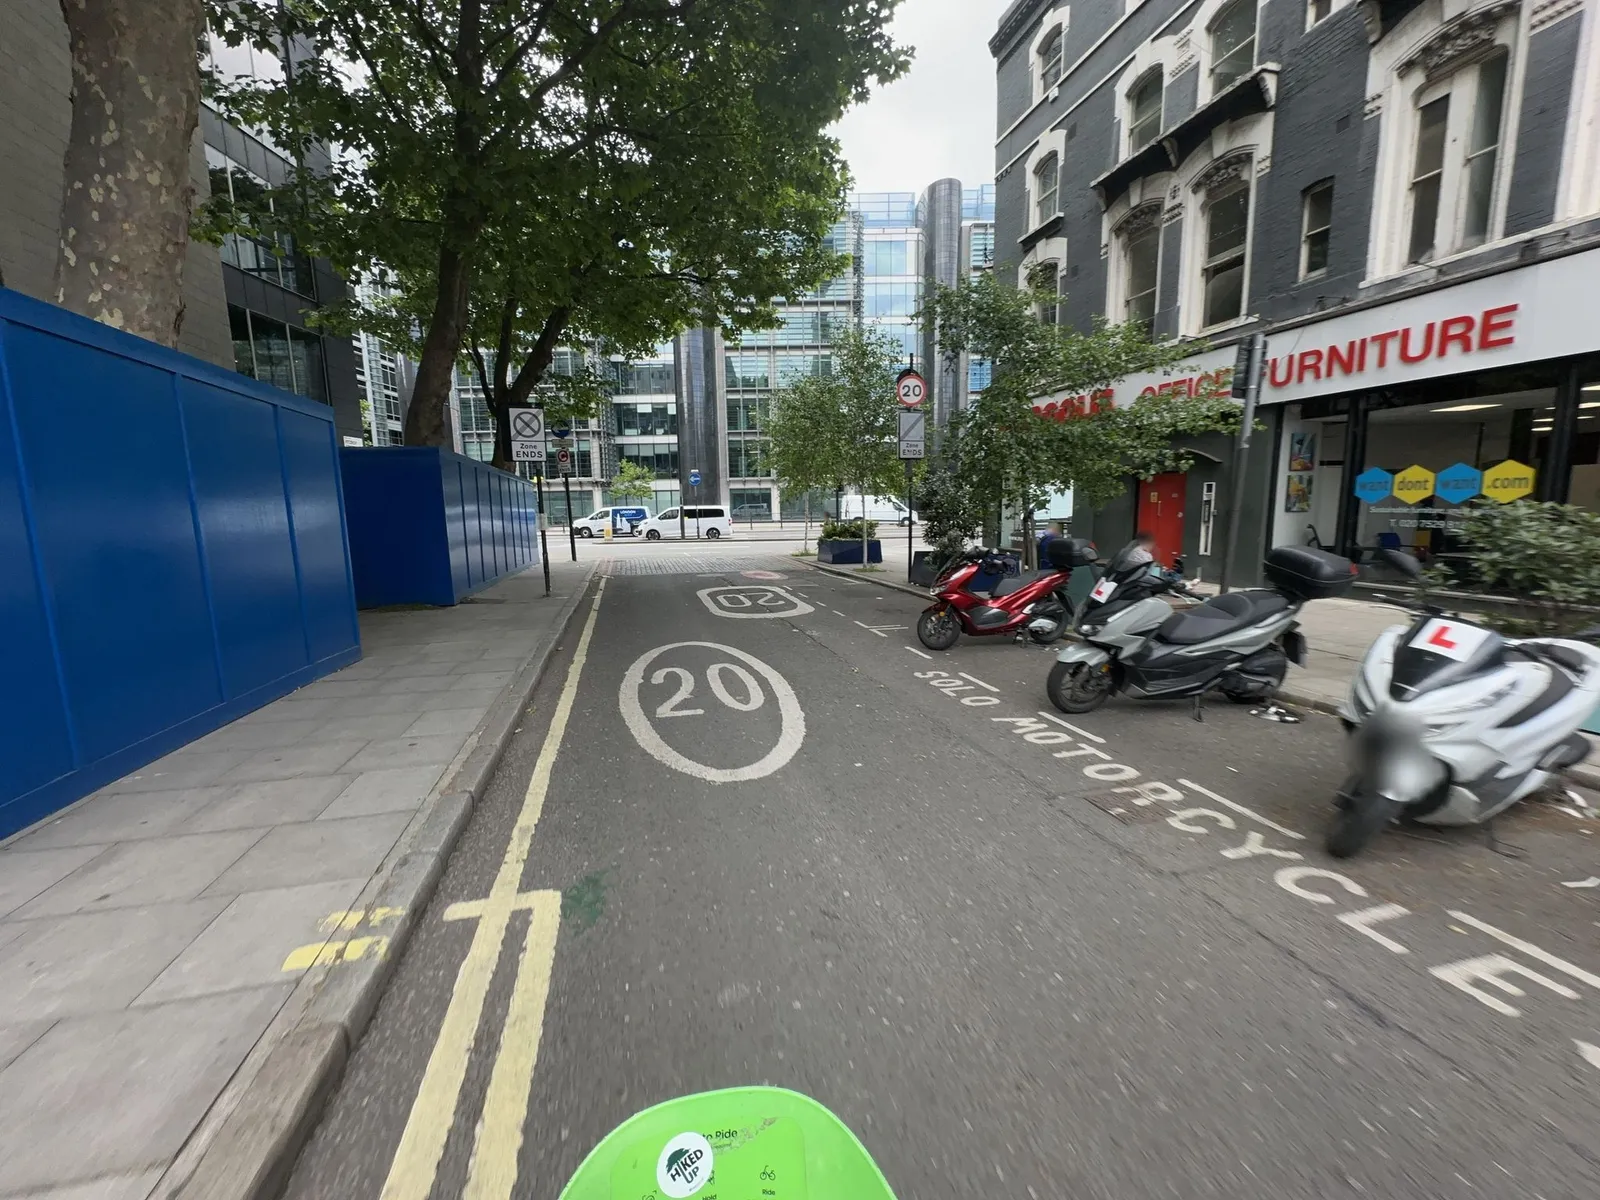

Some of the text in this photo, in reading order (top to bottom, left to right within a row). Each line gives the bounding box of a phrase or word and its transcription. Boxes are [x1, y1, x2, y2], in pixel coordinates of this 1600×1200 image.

[1263, 303, 1520, 389] URNITURE
[902, 384, 922, 397] 20
[515, 450, 543, 458] ENDS
[1358, 476, 1529, 491] want dont want .com
[717, 591, 785, 608] 20
[1427, 625, 1458, 650] L
[650, 662, 765, 718] 20
[912, 670, 1001, 708] SOLO
[990, 716, 1600, 1070] MOTORCYCLE
[715, 1129, 738, 1139] Ride
[670, 1149, 704, 1182] HIKED
[683, 1165, 700, 1184] UP
[762, 1188, 776, 1196] Ride
